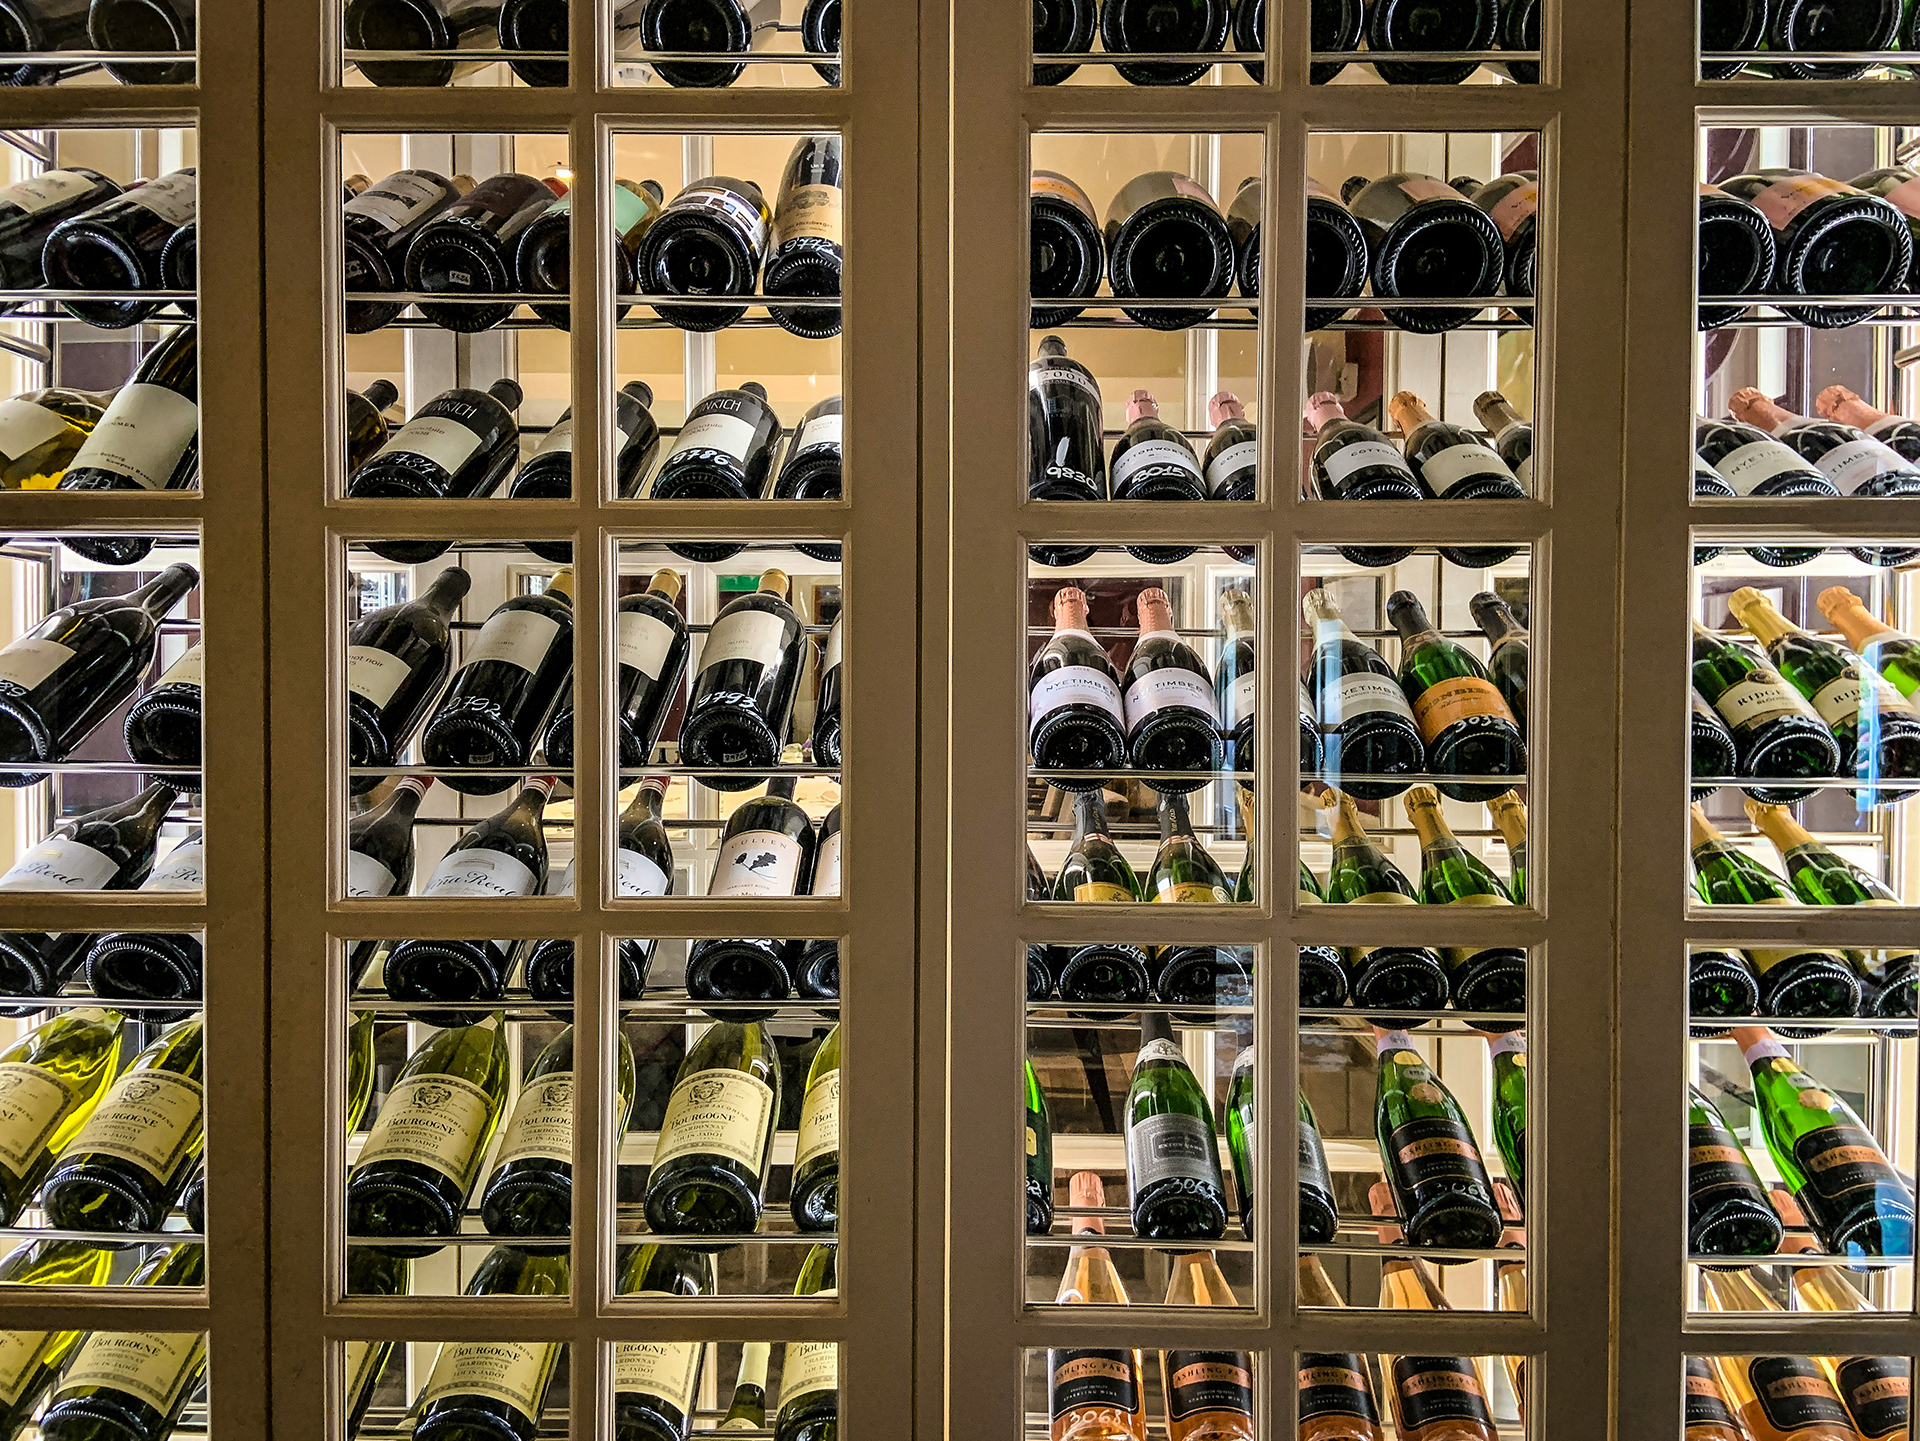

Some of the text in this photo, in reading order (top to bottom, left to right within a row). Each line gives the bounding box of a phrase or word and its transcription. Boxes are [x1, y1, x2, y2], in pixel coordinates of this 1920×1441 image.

[1042, 370, 1086, 386] 2000
[672, 449, 732, 465] 9786
[1115, 446, 1192, 475] COTTONWORTH
[1046, 466, 1098, 491] 9830
[366, 658, 384, 668] noir
[1046, 678, 1116, 697] NYETIMBER
[1132, 681, 1203, 703] NTIMBER
[731, 838, 787, 849] CULLEN
[387, 1117, 456, 1136] BOURGOGNE
[671, 1112, 736, 1130] BOURGOGNE
[453, 1345, 521, 1363] BOURGOGNE
[1056, 1362, 1097, 1380] ASHLING
[1176, 1367, 1222, 1382] ASHLING
[1069, 1409, 1122, 1426] 3068
